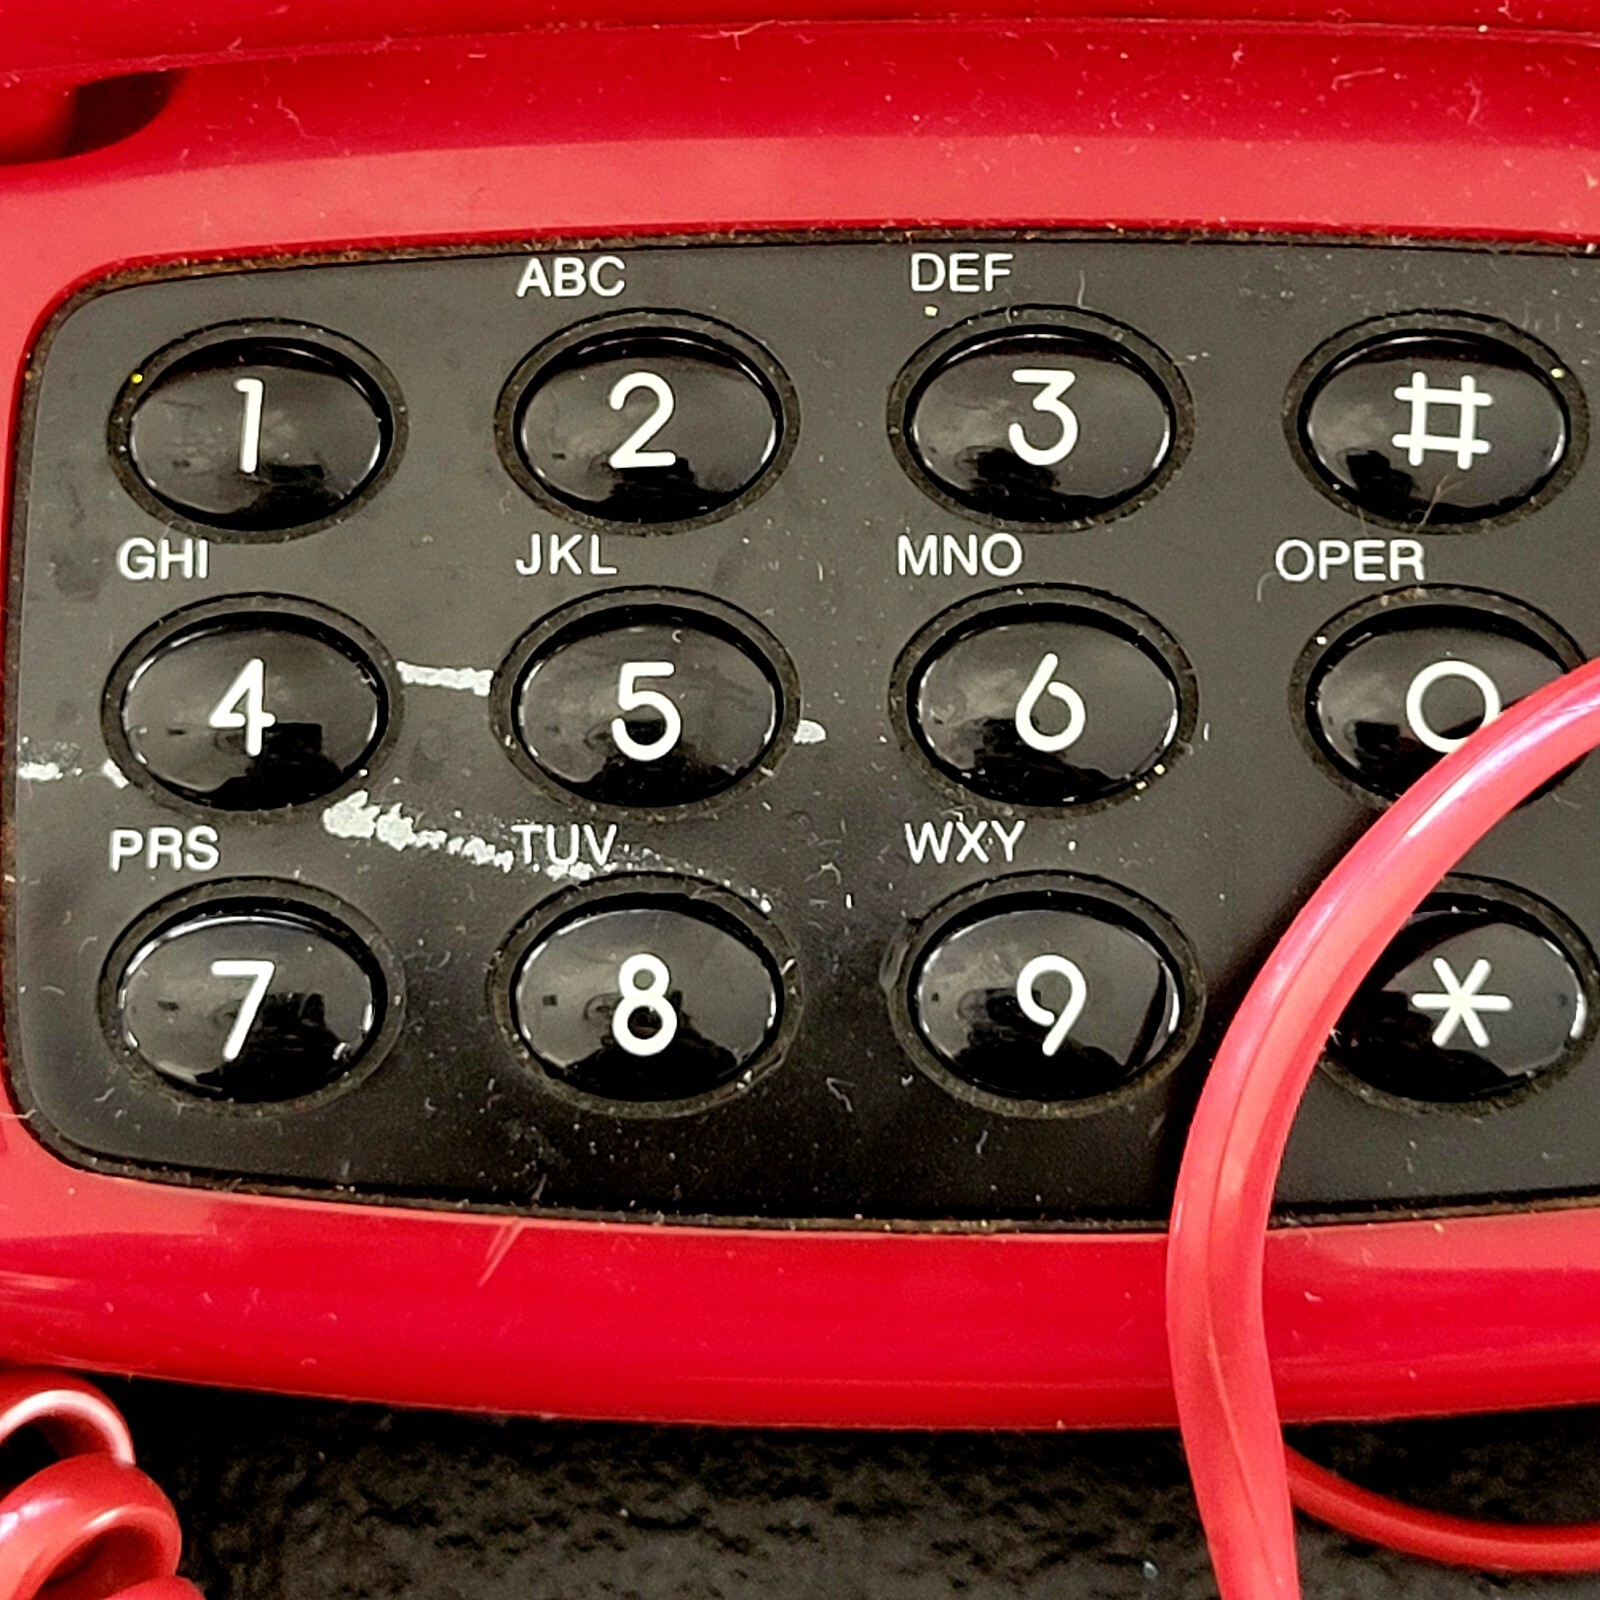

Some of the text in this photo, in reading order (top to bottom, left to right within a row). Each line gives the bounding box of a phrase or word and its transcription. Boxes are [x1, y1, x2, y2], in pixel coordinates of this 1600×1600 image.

[517, 256, 624, 297] ABC
[912, 253, 1013, 292] DEF
[235, 379, 262, 472] 1
[610, 372, 675, 468] 2
[1009, 370, 1077, 465] 3
[117, 538, 207, 580] GHI
[516, 534, 617, 575] JKL
[898, 533, 1022, 576] MNO
[1276, 540, 1424, 581] OPER
[208, 659, 275, 756] 4
[612, 662, 680, 760] 5
[1016, 654, 1085, 751] 6
[110, 826, 219, 871] PRS
[515, 822, 616, 865] TUV
[905, 821, 1025, 863] WXY
[210, 961, 274, 1060] 7
[613, 954, 677, 1055] 8
[1017, 955, 1086, 1056] 9
